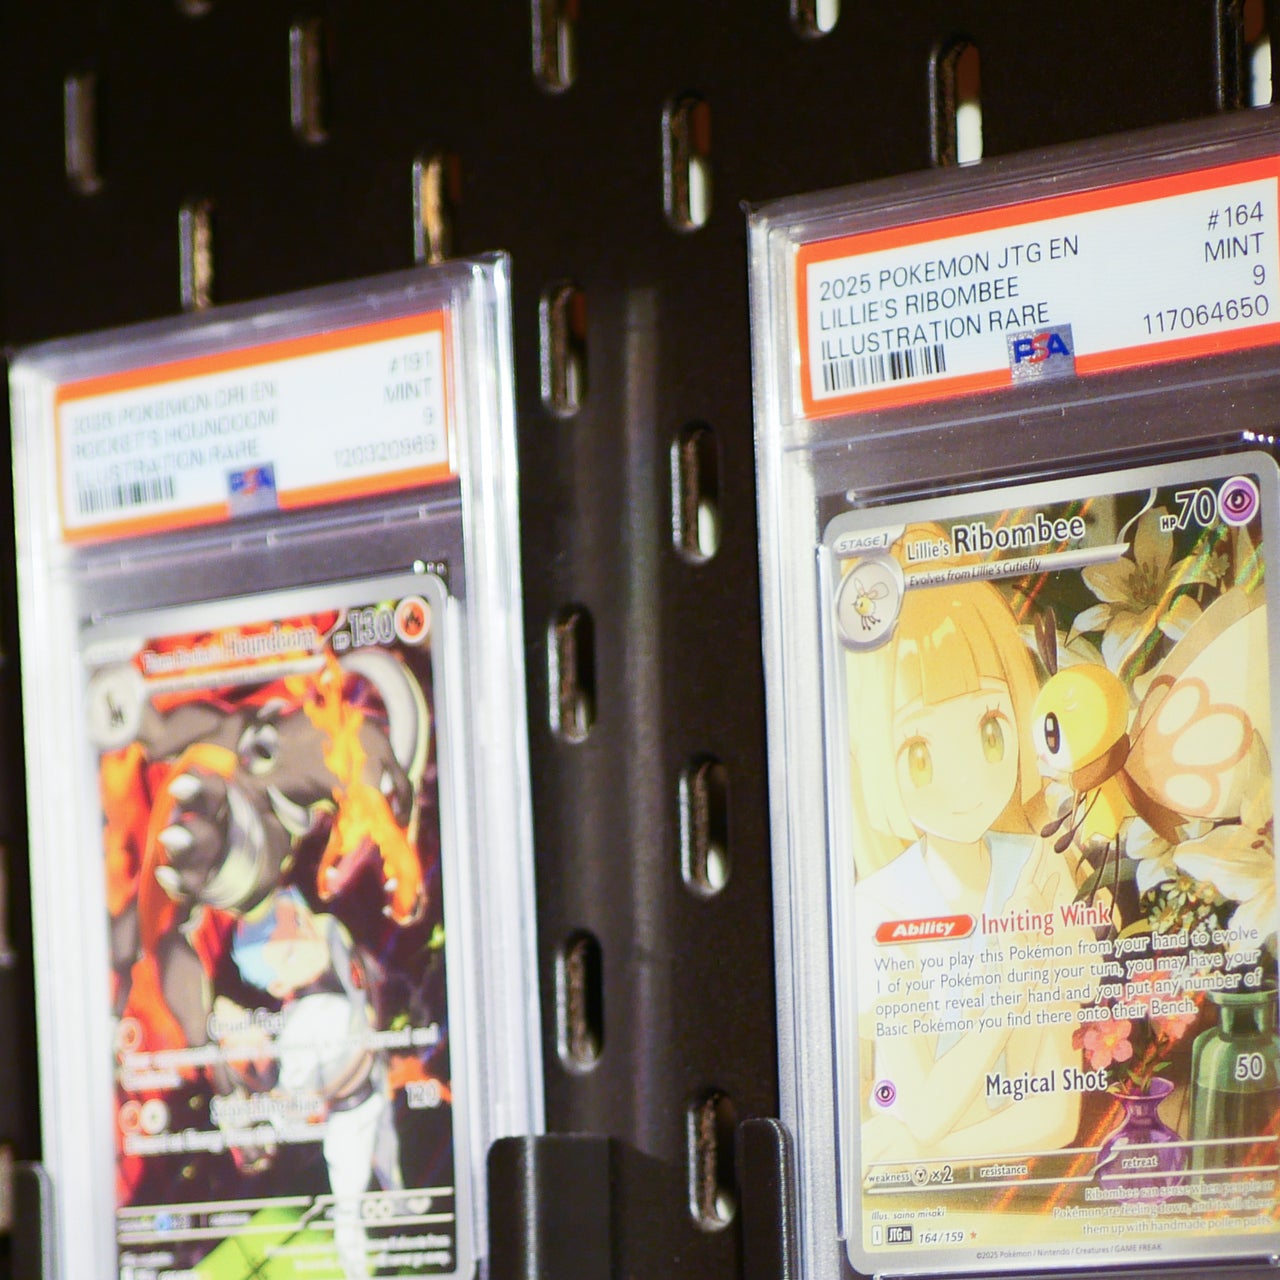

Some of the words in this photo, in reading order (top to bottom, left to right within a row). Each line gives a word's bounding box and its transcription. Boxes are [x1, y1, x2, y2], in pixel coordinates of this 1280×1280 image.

[1207, 202, 1263, 232] #164
[1204, 233, 1264, 264] MINT
[820, 273, 871, 302] 2025
[879, 251, 989, 290] POKEMON
[998, 243, 1041, 268] JTG
[1050, 235, 1079, 259] EN
[1252, 265, 1266, 287] 9
[820, 298, 898, 330] LILLIE'S
[906, 276, 1019, 315] RIBOMBEE
[1143, 295, 1270, 335] 117064650
[822, 314, 981, 360] ILLUSTRATION
[989, 302, 1050, 332] RARE
[1013, 333, 1070, 363] PSA
[385, 377, 432, 403] MINT
[1161, 516, 1176, 531] HP
[1177, 489, 1214, 526] 70
[907, 540, 949, 560] Lillie's
[954, 514, 1084, 553] Ribombee
[910, 571, 945, 586] Evolves
[947, 568, 970, 582] from
[972, 564, 1001, 578] Lillie's
[1003, 559, 1040, 574] Cutiefly
[892, 920, 955, 938] Ability
[981, 909, 1054, 936] Inviting
[1060, 902, 1111, 928] Wink
[874, 956, 915, 972] When
[920, 956, 944, 973] you
[949, 951, 975, 971] play
[980, 947, 1004, 964] this
[1009, 942, 1073, 961] Pokémon
[1078, 938, 1112, 954] from
[1116, 938, 1149, 957] your
[1152, 931, 1187, 949] hand
[1192, 931, 1209, 944] to
[1212, 926, 1258, 943] evolve
[888, 977, 902, 993] of
[905, 977, 935, 996] your
[941, 972, 1002, 989] Pokémon
[1007, 967, 1050, 985] during
[1054, 965, 1084, 984] your
[1090, 962, 1122, 978] turn,
[1126, 959, 1153, 978] you
[1157, 955, 1186, 975] may
[1189, 951, 1222, 967] have
[1225, 950, 1259, 971] your
[876, 998, 940, 1019] opponent
[945, 993, 985, 1010] reveal
[990, 990, 1023, 1007] their
[1028, 986, 1061, 1003] hand
[1066, 984, 1091, 1000] and
[1096, 984, 1121, 1003] you
[1126, 980, 1150, 999] put
[1155, 978, 1180, 996] any
[1184, 973, 1240, 990] number
[1244, 970, 1262, 986] of
[876, 1022, 908, 1037] Basic
[913, 1017, 974, 1034] Pokémon
[979, 1016, 1002, 1033] you
[1007, 1010, 1031, 1026] find
[1036, 1008, 1072, 1024] there
[1077, 1005, 1109, 1020] onto
[1113, 1002, 1146, 1019] their
[1151, 998, 1198, 1015] Bench.
[986, 1067, 1056, 1101] Magical
[1062, 1067, 1107, 1093] Shot
[1237, 1055, 1263, 1080] 50
[869, 1172, 910, 1183] weakness
[980, 1165, 1027, 1177] resistance
[1122, 1156, 1158, 1168] retreat
[919, 1231, 964, 1244] 164/159
